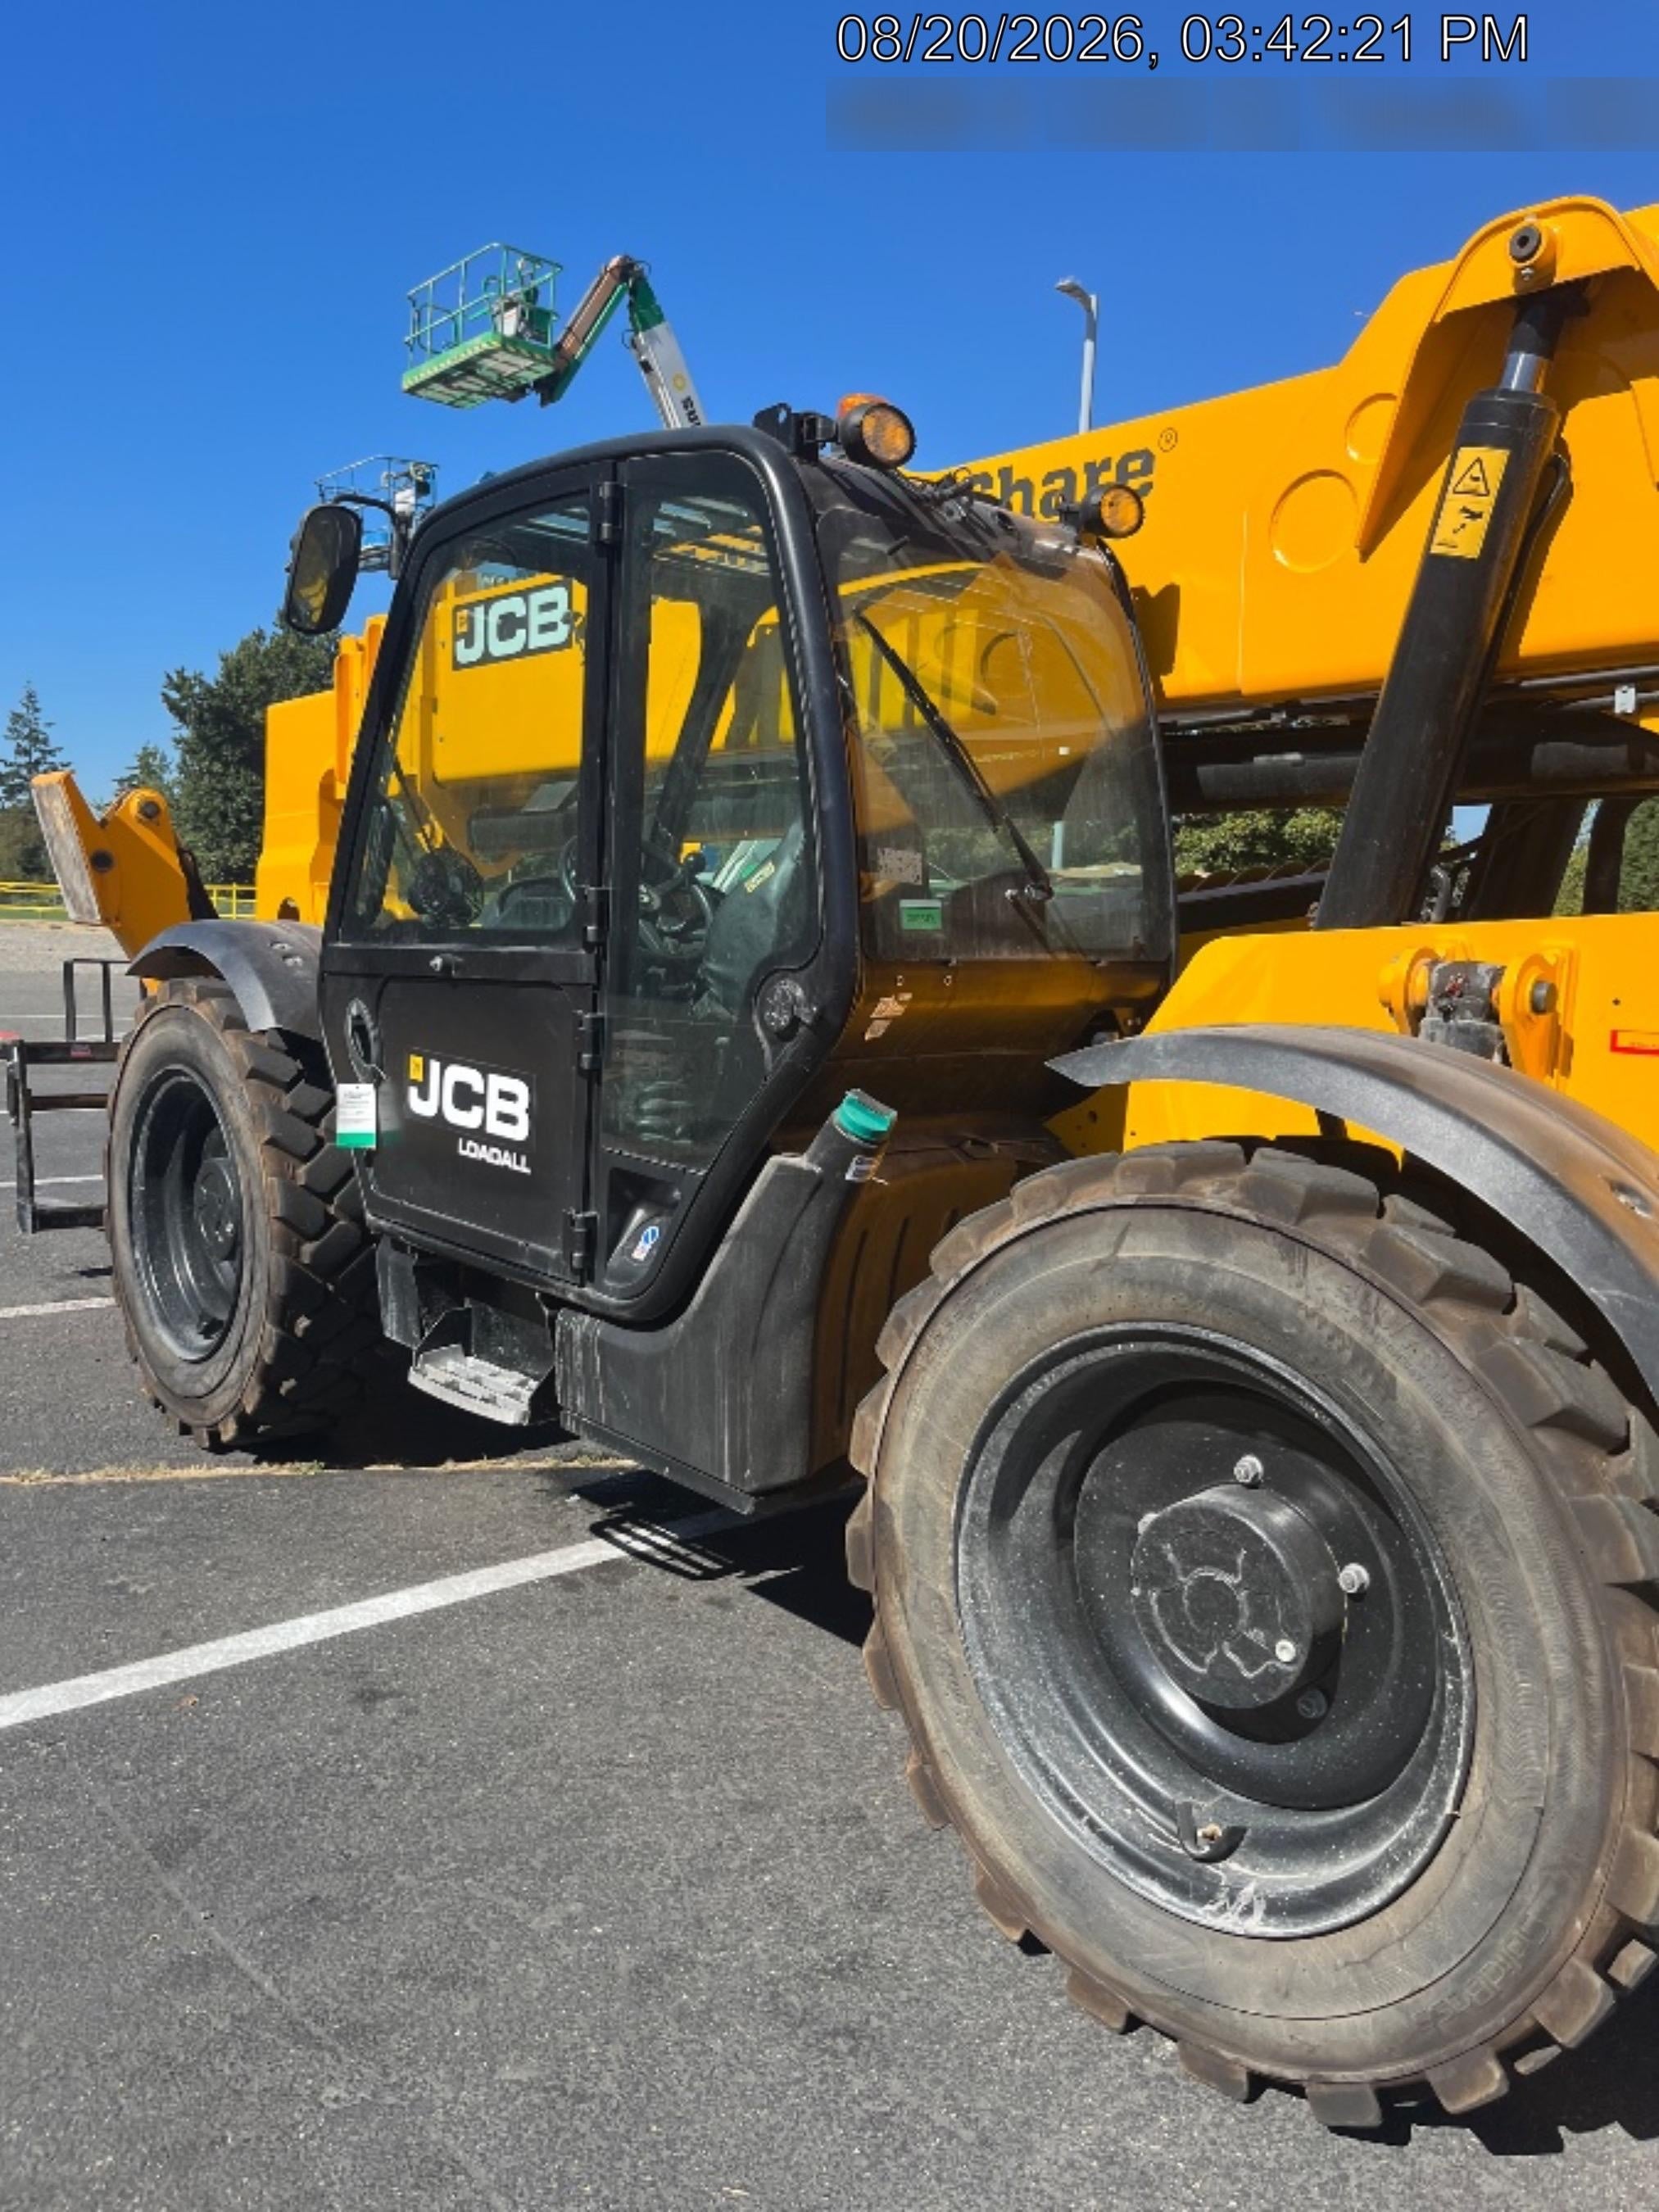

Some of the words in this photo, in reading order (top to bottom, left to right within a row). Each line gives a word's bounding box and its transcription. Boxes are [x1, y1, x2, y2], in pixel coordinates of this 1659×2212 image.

[456, 587, 570, 664] JCB
[408, 1058, 529, 1141] JCB
[457, 1137, 531, 1175] LOADALL
